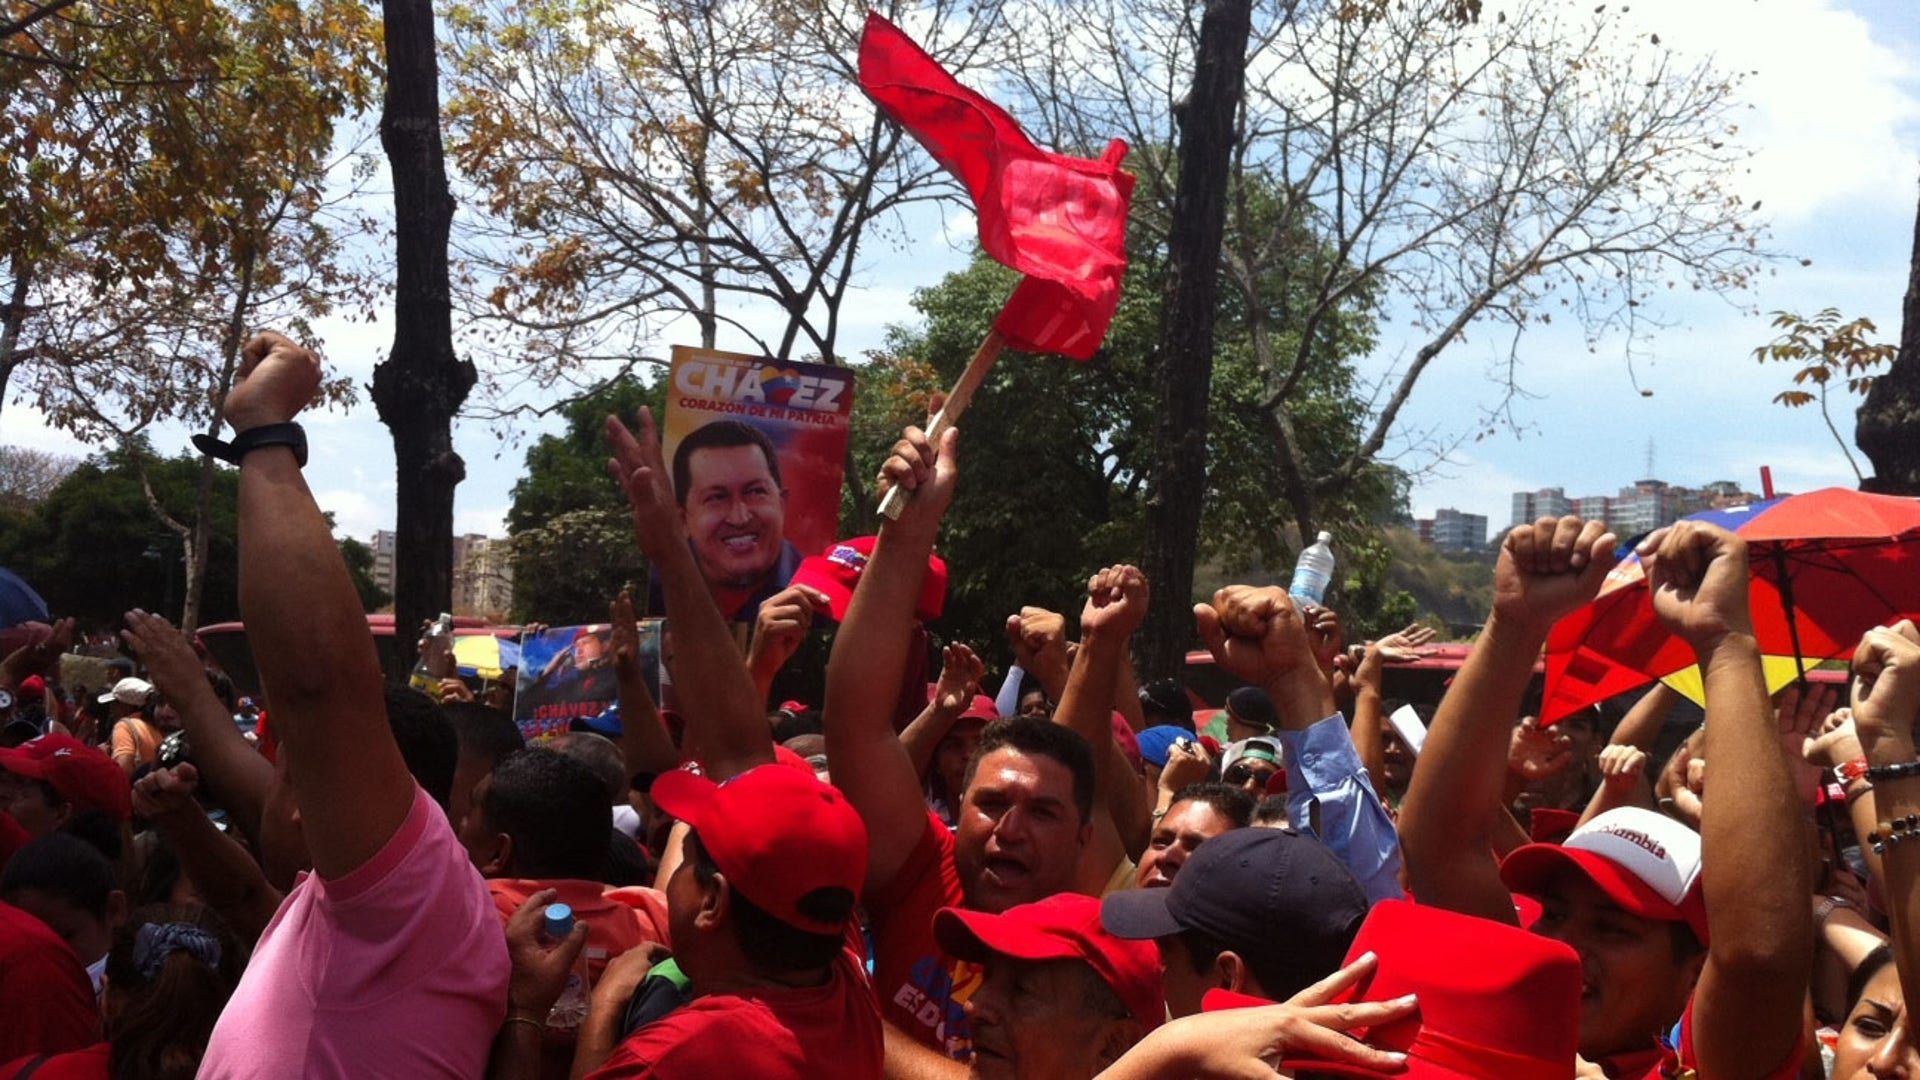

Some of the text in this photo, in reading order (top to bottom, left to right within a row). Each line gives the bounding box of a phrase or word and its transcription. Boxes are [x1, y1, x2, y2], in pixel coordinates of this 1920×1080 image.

[749, 405, 766, 417] DE
[769, 407, 785, 419] MI
[788, 409, 835, 425] PATRIA
